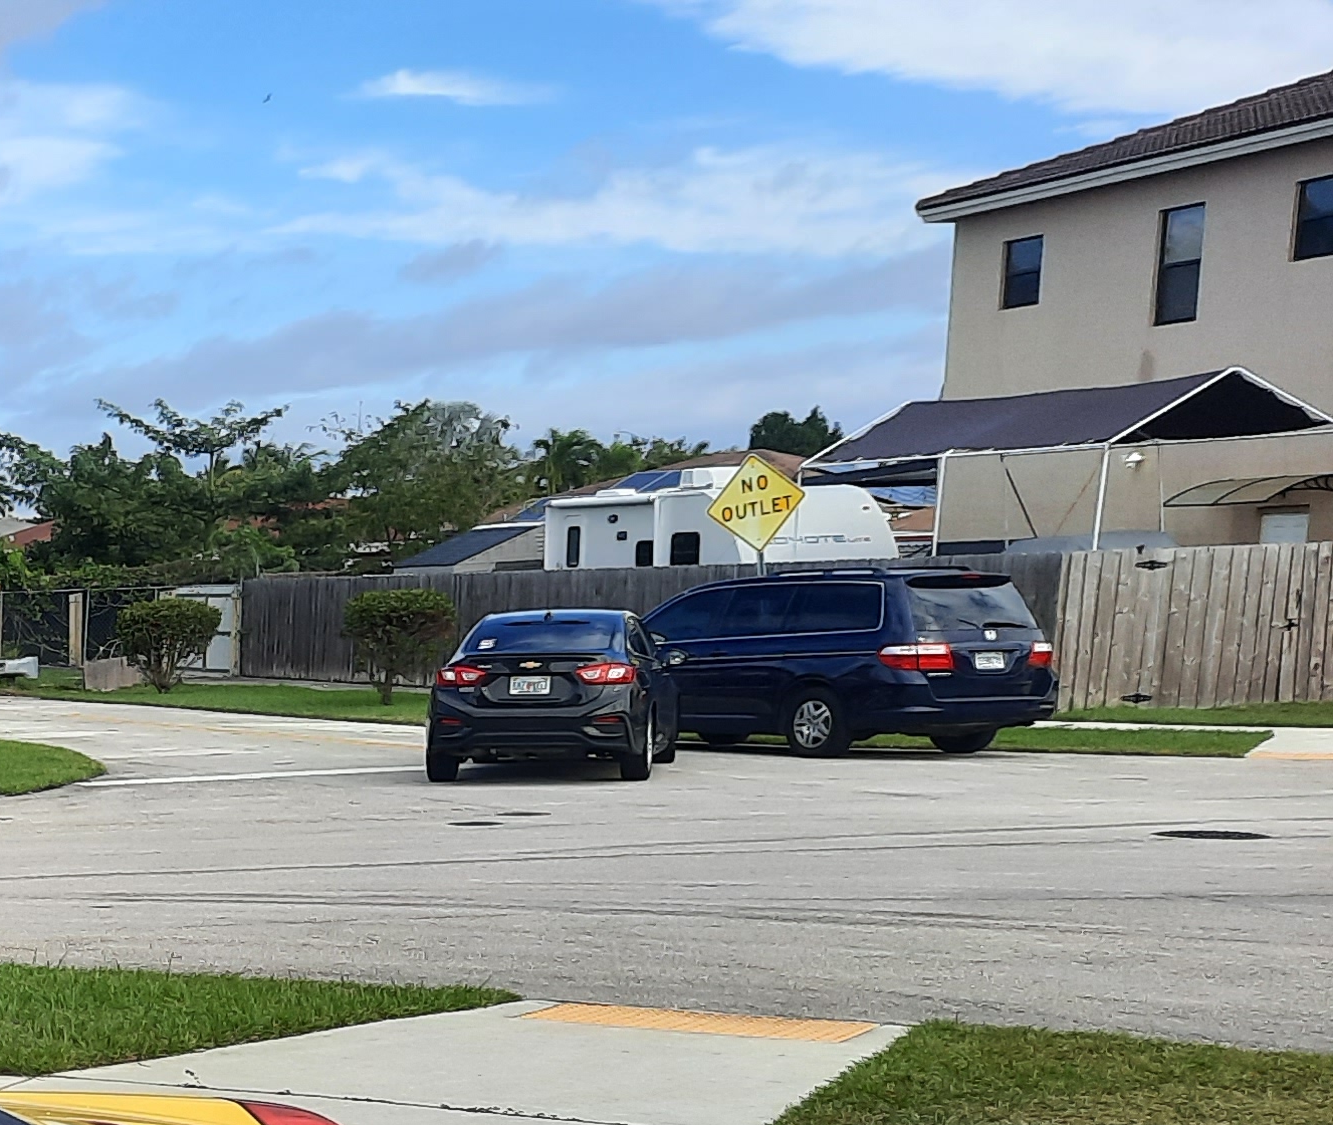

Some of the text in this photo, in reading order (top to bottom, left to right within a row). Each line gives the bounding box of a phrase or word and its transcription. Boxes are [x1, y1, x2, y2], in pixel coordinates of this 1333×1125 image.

[741, 475, 768, 494] NO
[721, 495, 792, 522] OUTLET
[767, 534, 846, 545] OYOTE
